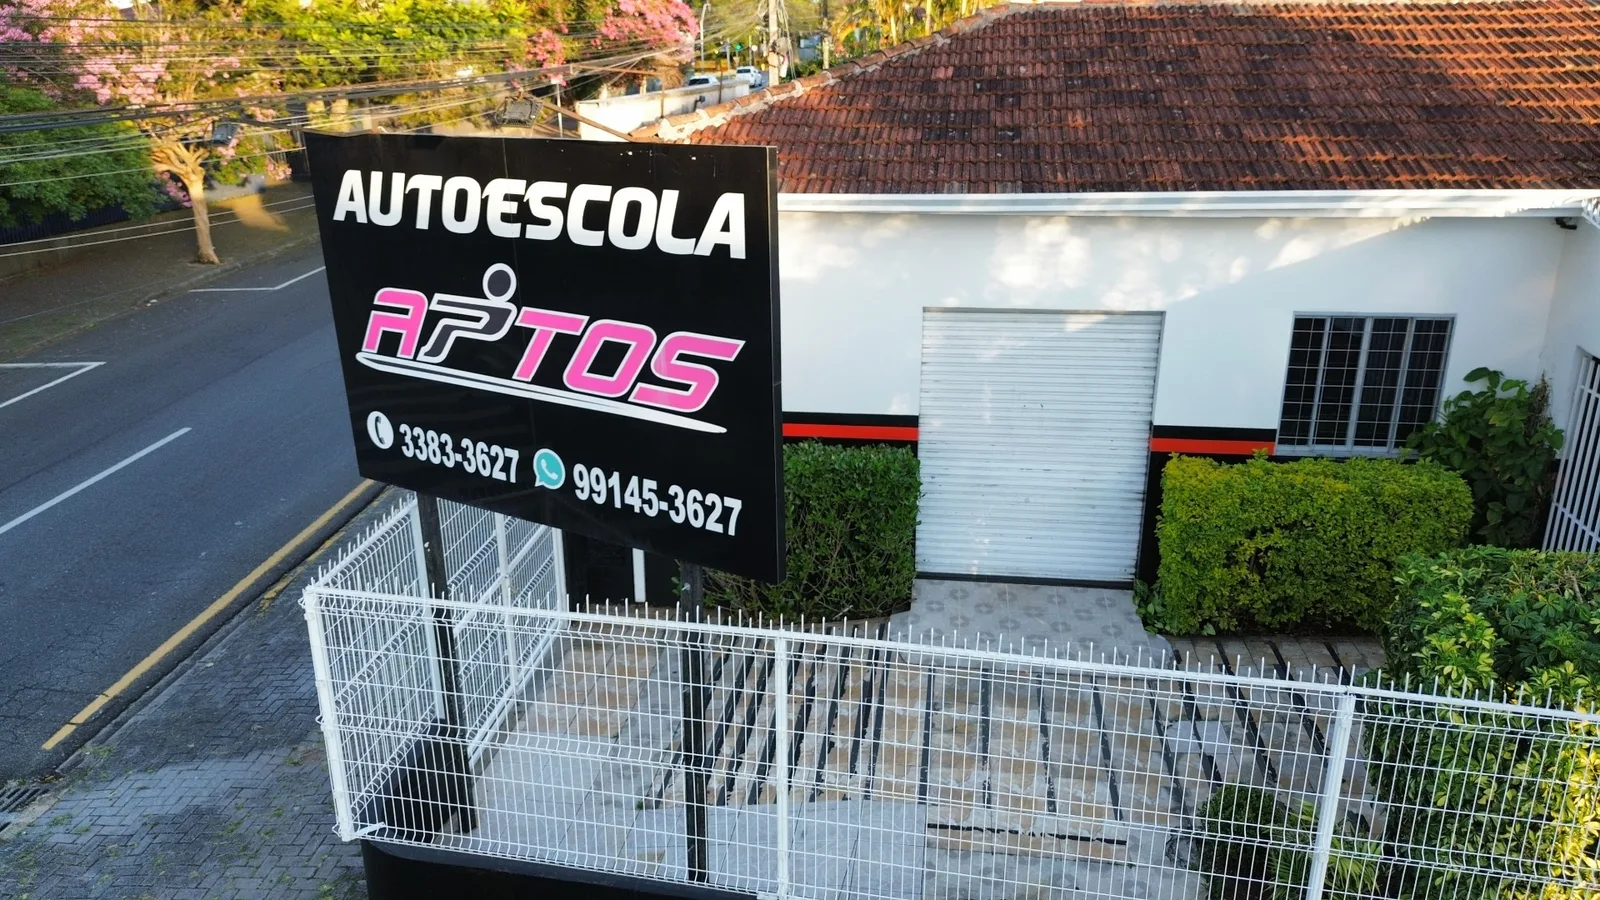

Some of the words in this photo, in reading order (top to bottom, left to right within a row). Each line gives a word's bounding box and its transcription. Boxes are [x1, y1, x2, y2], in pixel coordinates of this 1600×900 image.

[333, 169, 746, 259] AUTOESCOLA
[361, 264, 746, 413] APTOS
[399, 423, 519, 483] 3383-3627
[573, 464, 742, 536] 99145-3627
